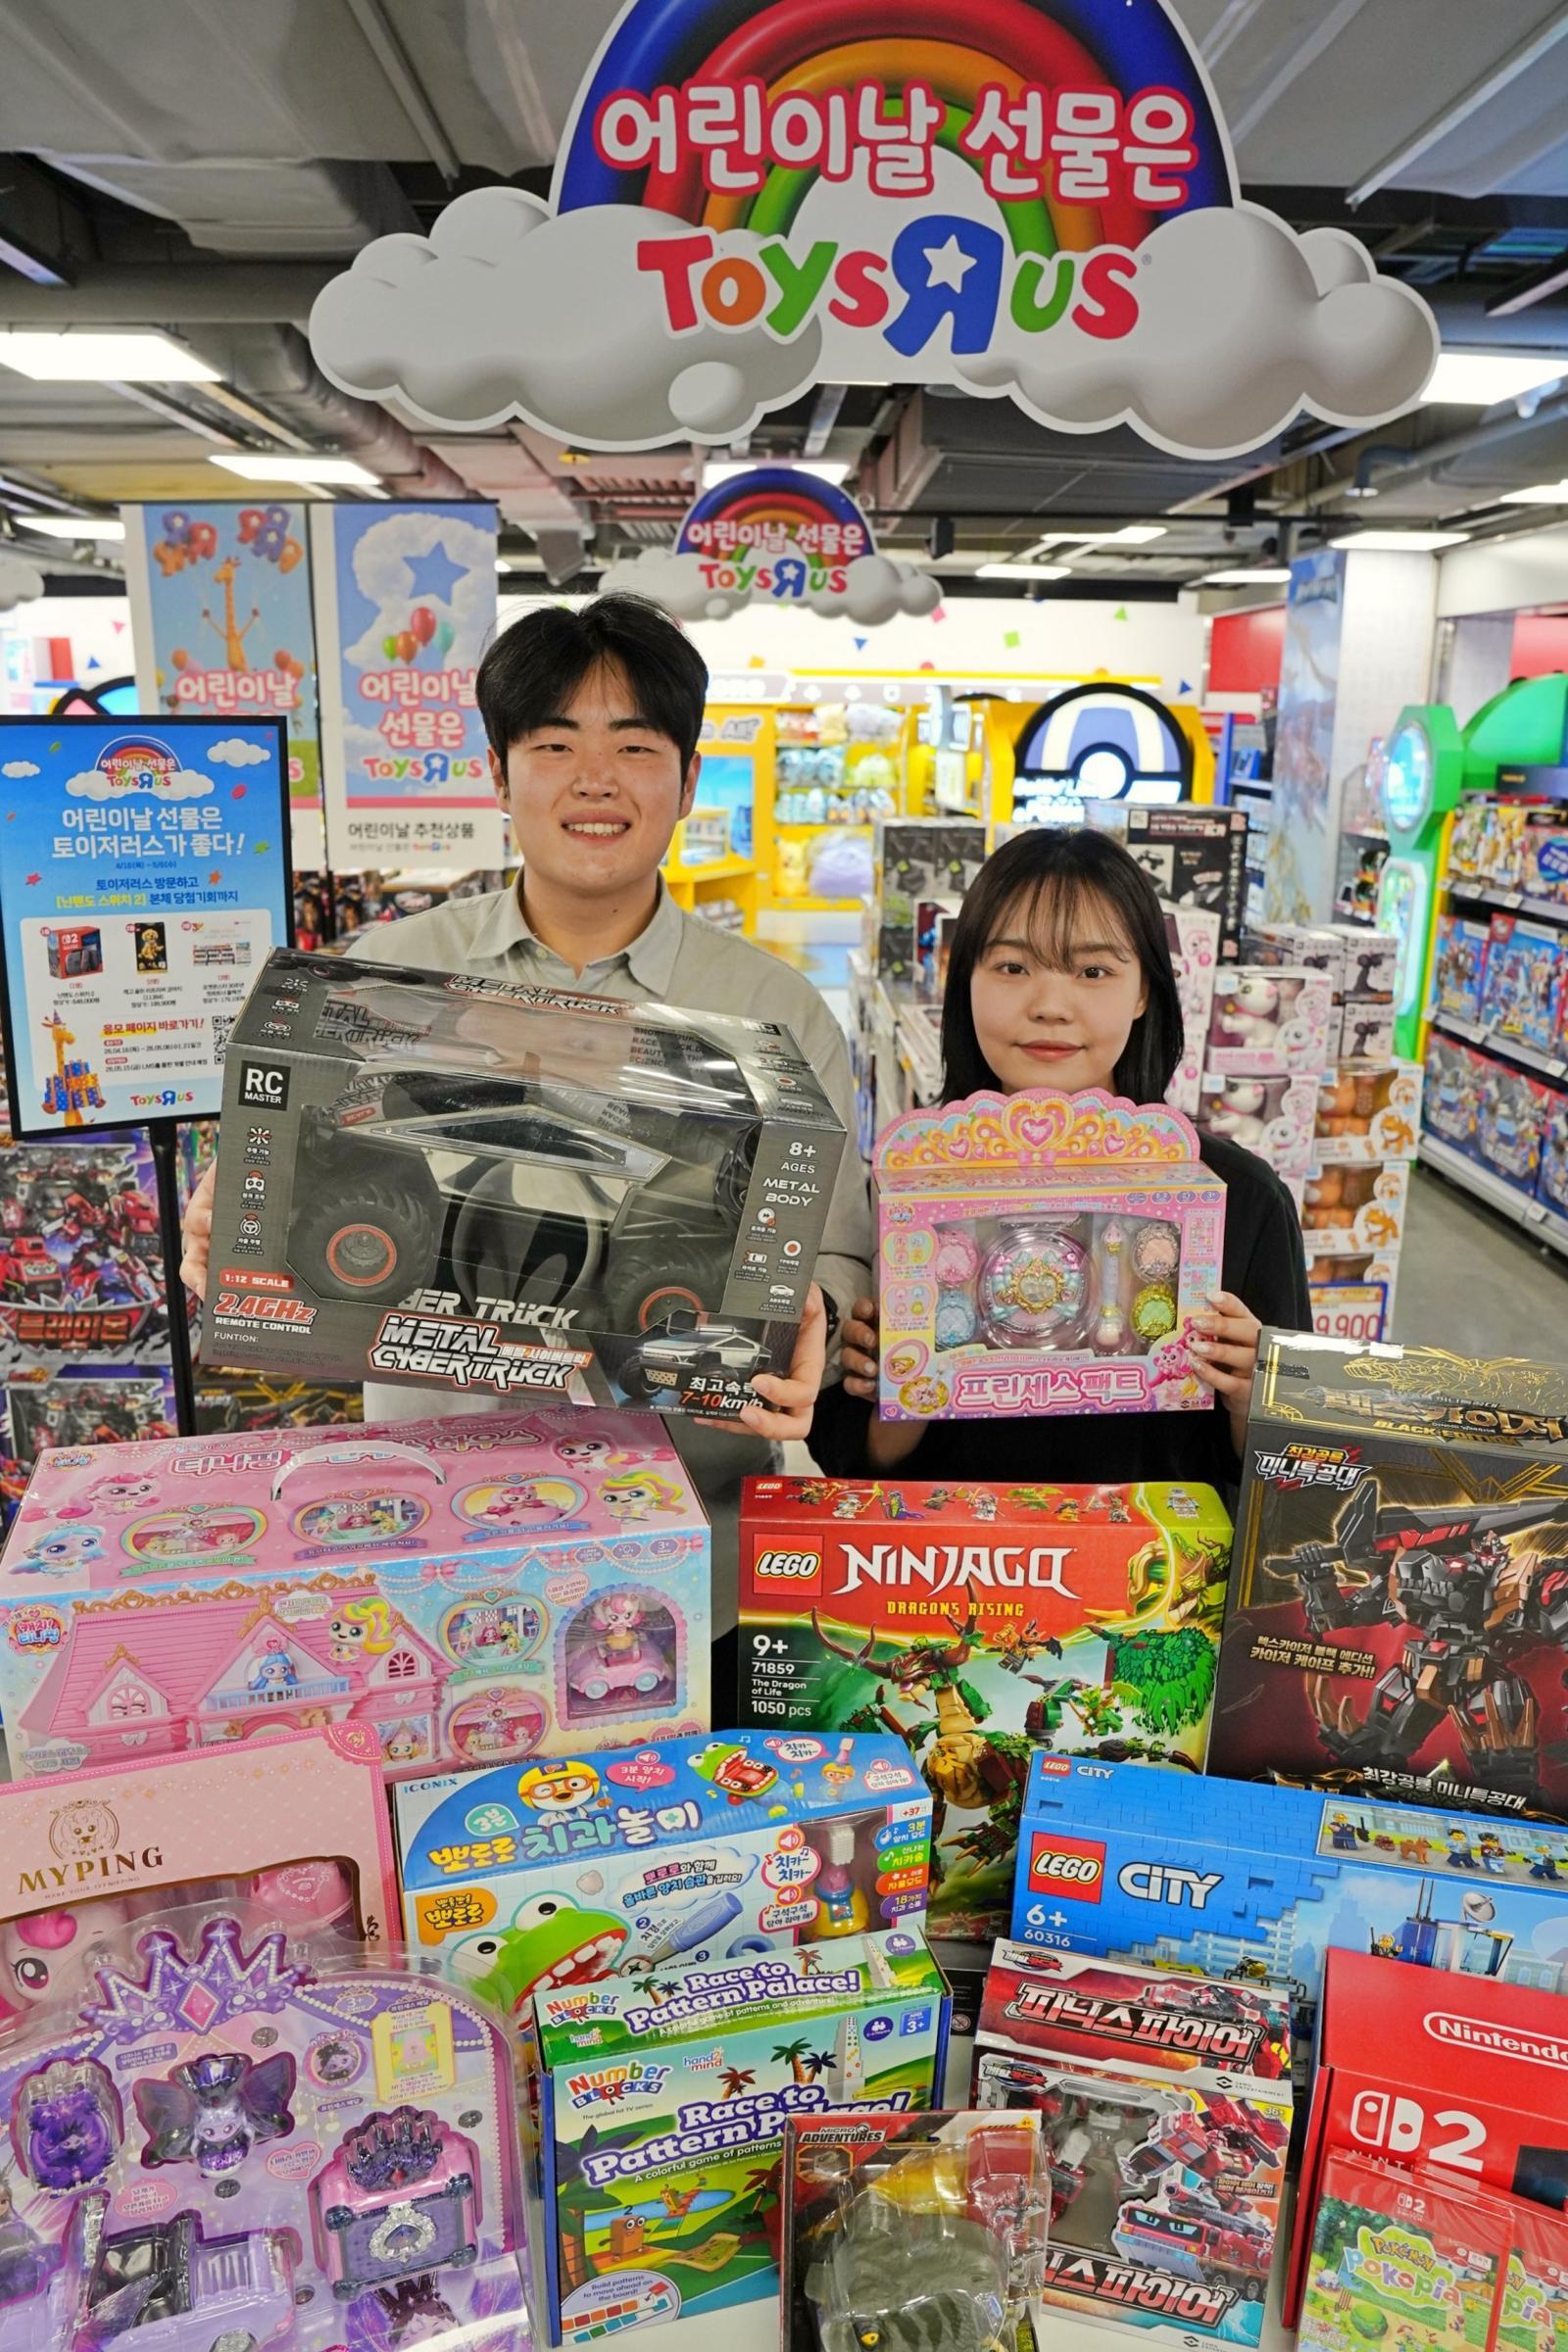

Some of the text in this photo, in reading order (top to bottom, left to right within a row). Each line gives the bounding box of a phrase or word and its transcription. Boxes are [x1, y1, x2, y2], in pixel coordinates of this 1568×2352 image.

[597, 80, 1197, 201] 어린이날 선물은
[688, 520, 864, 556] 어린이날 선물은
[175, 671, 297, 704] 어린이날
[381, 711, 465, 747] 선물은
[100, 758, 176, 771] 어린이날 선물은
[62, 807, 222, 833] 어린이날 선물은
[348, 822, 474, 840] 어린이날 추천상품
[52, 833, 246, 859] 토이저러스가 좋다!
[96, 876, 199, 892] 토이저러스 방문하고
[150, 891, 239, 906] 본체 당첨기회까지
[103, 1018, 205, 1035] 응모 페이지 바로가기!
[245, 1067, 284, 1095] RC
[244, 1091, 282, 1104] MASTER
[788, 1141, 817, 1158] 8+
[780, 1161, 816, 1174] AGES
[762, 1177, 821, 1194] METAL
[764, 1192, 813, 1207] BODY
[224, 1274, 290, 1288] 1:12 SCALE
[213, 1293, 318, 1325] 2.4GHz
[215, 1317, 312, 1335] REMOTE CONTROL
[379, 1314, 502, 1356] METAL
[1315, 1313, 1381, 1341] 9900
[214, 1331, 260, 1343] FUNTION:
[689, 1375, 759, 1397] 최고속력
[1373, 1419, 1436, 1437] BLACK
[174, 1449, 283, 1475] 티니핑
[1286, 1445, 1345, 1464] 최강공룡
[1258, 1454, 1362, 1487] 미니특공대
[756, 1482, 783, 1491] LEGO
[756, 1543, 1082, 1599] LEGO NINJAGO
[886, 1599, 1025, 1617] DRAGONS RISING
[18, 1629, 61, 1645] 티니핑
[752, 1635, 789, 1656] 9+
[1257, 1636, 1374, 1665] 렉스카이저 블랙 에디션
[752, 1661, 796, 1676] 71859
[1250, 1645, 1376, 1680] 카이저 케이프 추가!!
[752, 1679, 808, 1692] The Dragon
[752, 1687, 783, 1697] of Life
[751, 1701, 812, 1718] 1050 pcs
[783, 1741, 813, 1752] 치카~
[790, 1748, 819, 1759] 치카~
[620, 1763, 664, 1776] 3분 양치
[624, 1773, 652, 1785] 시작!
[1043, 1760, 1115, 1780] LEGO CITY
[403, 1778, 459, 1794] ICONIX
[1362, 1766, 1528, 1811] 최강공룡 미니특공대
[472, 1807, 508, 1833] 3분
[907, 1819, 926, 1833] 3분
[911, 1831, 926, 1840] 모드
[427, 1836, 517, 1875] 뽀로로
[775, 1854, 809, 1869] 치카~
[17, 1844, 165, 1895] MYPING
[643, 1859, 717, 1886] 뽀로로와 함께
[778, 1868, 811, 1882] 치카~
[1032, 1850, 1223, 1910] LEGO CITY
[622, 1873, 713, 1908] 올바른 양치 습관을
[424, 1902, 484, 1930] 뽀로로
[771, 1902, 808, 1919] 구석구석
[1025, 1904, 1068, 1928] 6+
[1023, 1929, 1071, 1948] 60316
[687, 1962, 789, 1993] Race to
[346, 1997, 363, 2009] 3+
[546, 1991, 620, 2016] Number
[626, 1970, 861, 2034] Pattern Palace!
[700, 1995, 836, 2025] game patterns and adventure!
[549, 2005, 617, 2028] BLOCKS
[906, 2020, 926, 2034] 3+
[690, 2060, 723, 2072] mind
[567, 2060, 671, 2096] Number
[572, 2080, 663, 2109] BLOCKS
[595, 2110, 615, 2120] global
[682, 2084, 821, 2130] Race to
[801, 2132, 883, 2143] ADVENTURES
[1428, 2110, 1488, 2173] 2
[588, 2124, 749, 2183] Pattern
[634, 2174, 644, 2183] A
[645, 2161, 687, 2180] colorful
[688, 2154, 720, 2170] game
[722, 2148, 735, 2159] of
[737, 2140, 782, 2157] patterns
[622, 2204, 634, 2216] 2
[1412, 2198, 1426, 2214] 2
[612, 2275, 645, 2287] patterns
[1343, 2246, 1460, 2307] Pokopia
[616, 2282, 642, 2292] ahead
[1045, 2250, 1235, 2327] 스파이어
